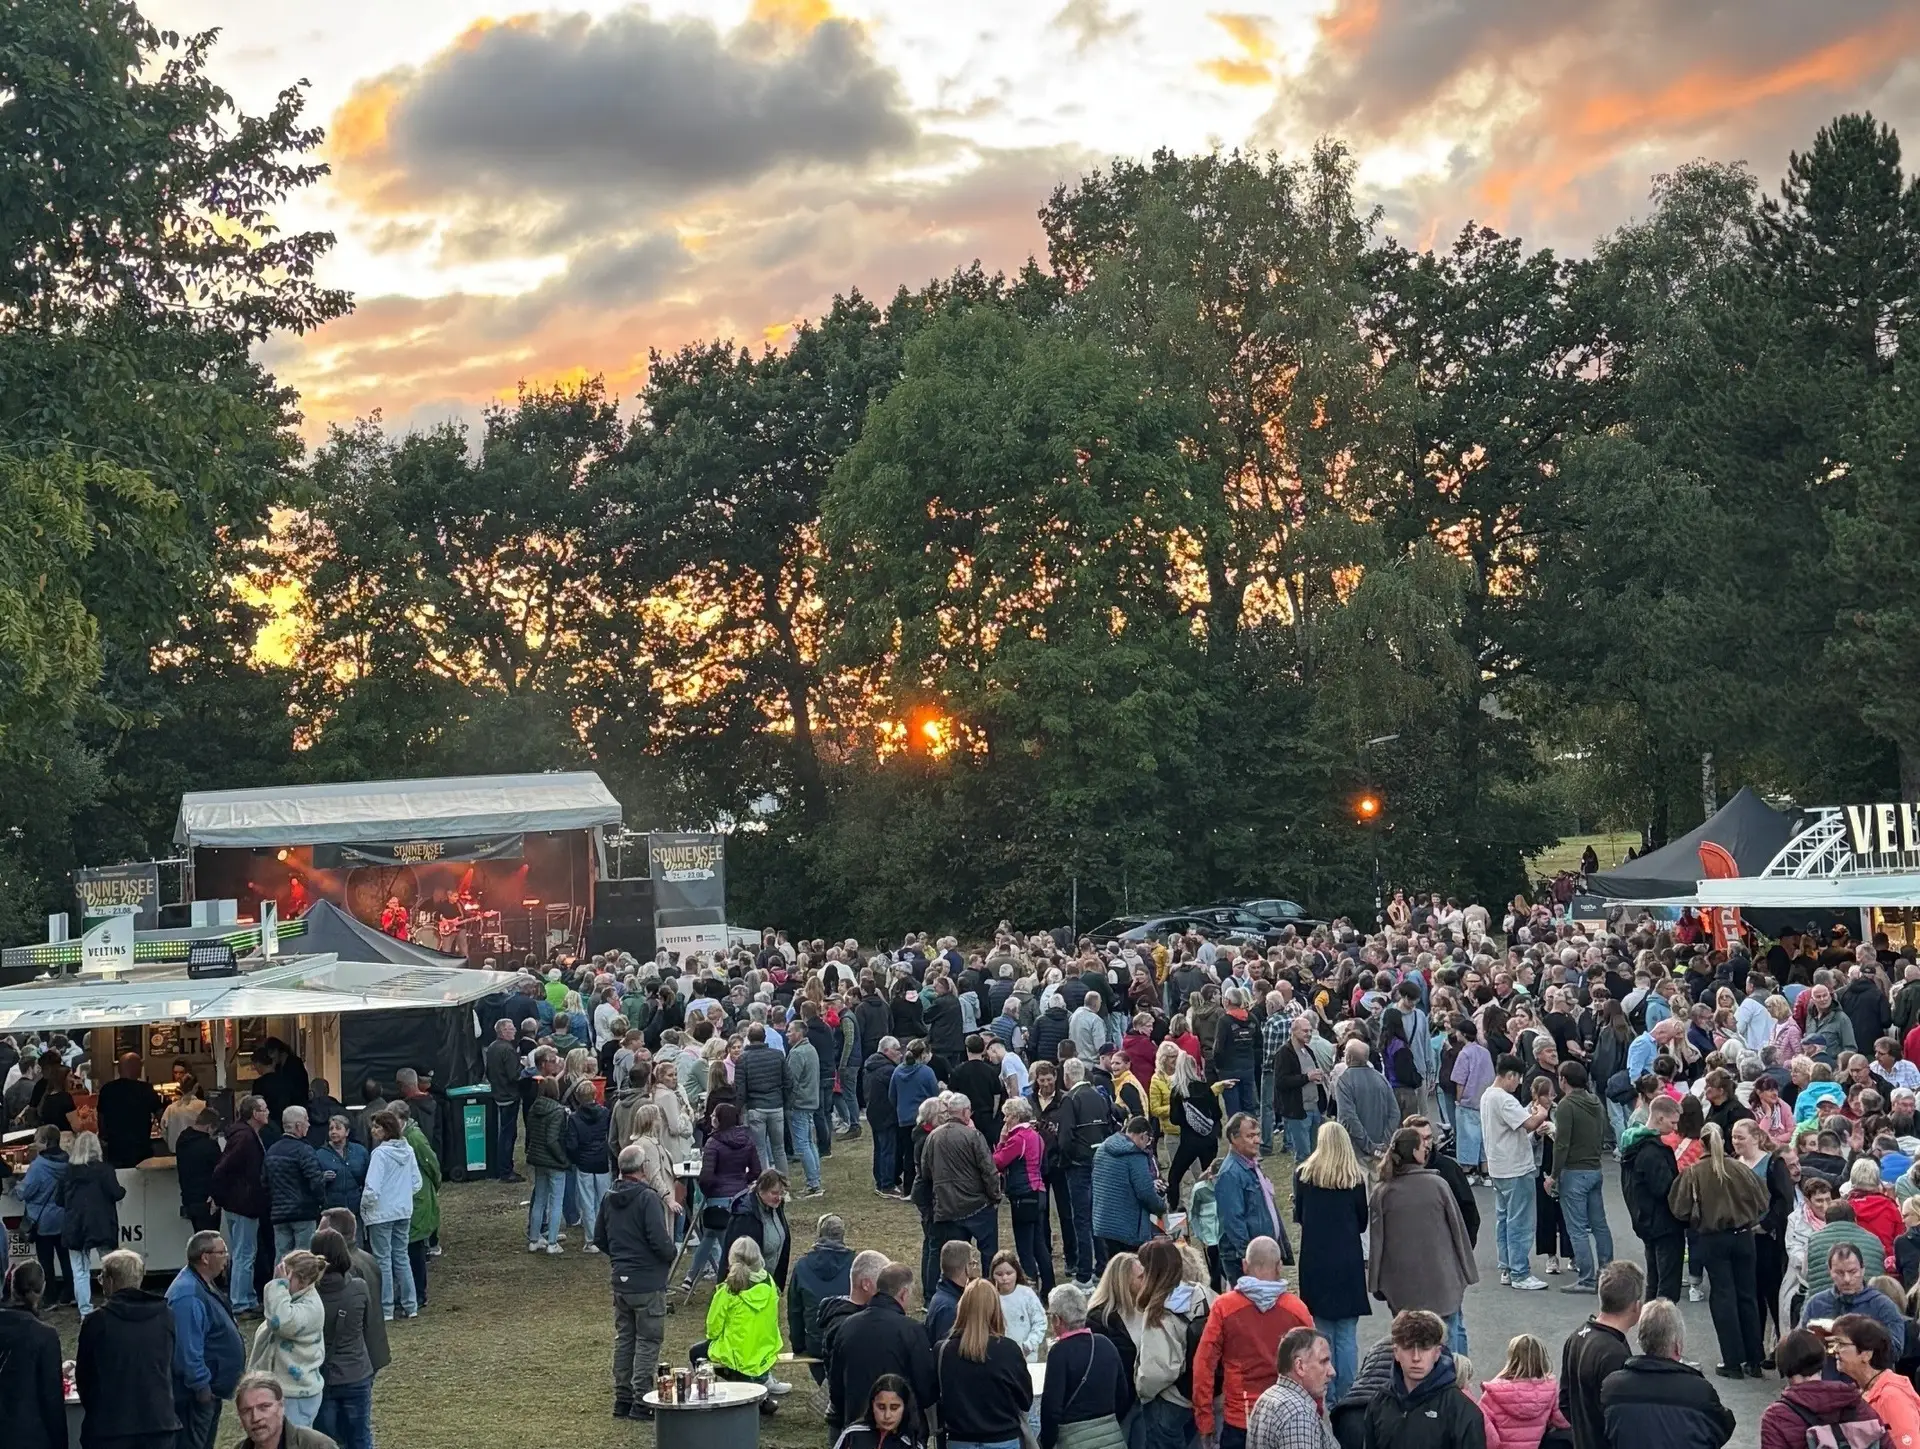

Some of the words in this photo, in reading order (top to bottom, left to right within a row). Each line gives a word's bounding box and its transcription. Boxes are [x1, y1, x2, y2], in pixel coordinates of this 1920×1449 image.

[1846, 803, 1920, 854] VEL
[394, 843, 445, 857] SONNENSEE
[652, 845, 723, 863] SONNENSEE
[401, 853, 421, 864] Open
[423, 852, 439, 861] Air
[663, 858, 691, 871] Open
[695, 856, 714, 870] Air
[76, 879, 154, 899] SONNENSEE
[86, 892, 117, 907] Open
[120, 891, 143, 905] Air
[88, 946, 126, 957] VELTINS
